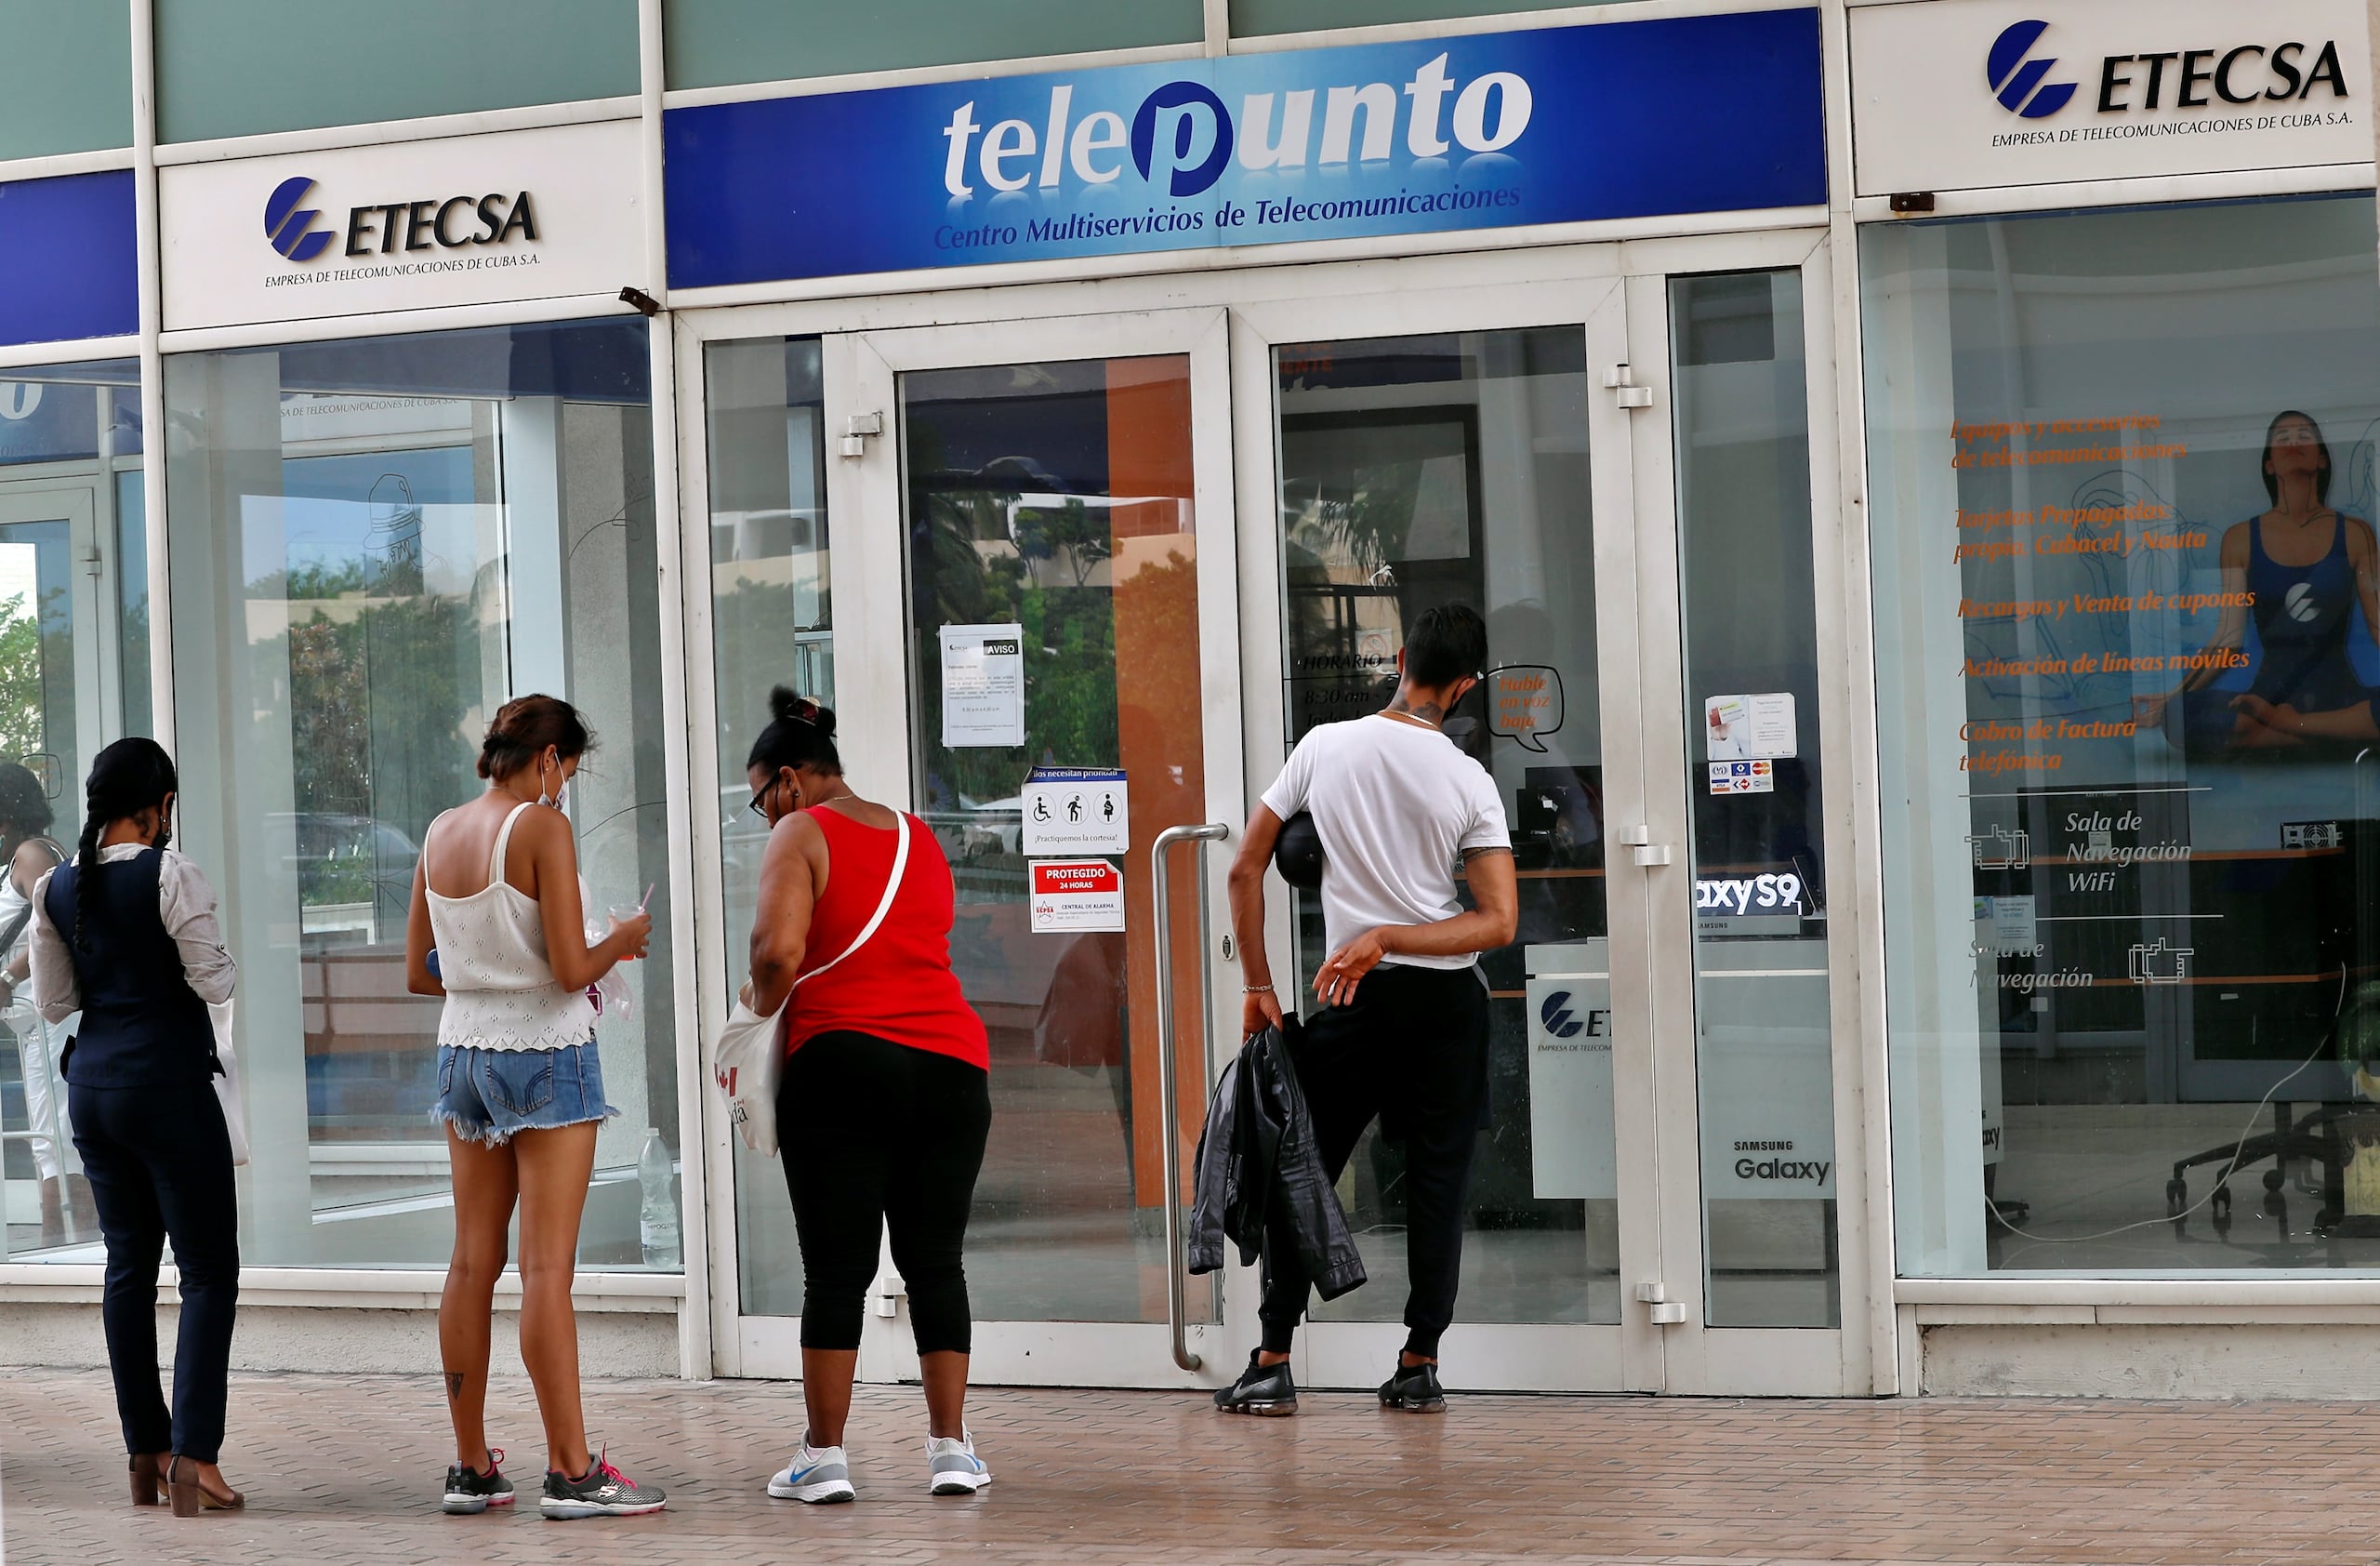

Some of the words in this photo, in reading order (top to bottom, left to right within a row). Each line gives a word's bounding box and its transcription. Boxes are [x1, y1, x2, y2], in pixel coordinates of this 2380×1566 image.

[2097, 41, 2349, 113] ETECSA
[943, 51, 1533, 196] telepunto
[1992, 131, 2055, 147] EMPRESA
[2059, 130, 2078, 143] DE
[2082, 117, 2253, 141] TELECOMUNICACIONES
[2257, 116, 2277, 130] DE
[2281, 113, 2321, 128] CUBA
[2326, 112, 2353, 126] S.A.
[345, 191, 537, 256] ETECSA
[935, 223, 1017, 249] Centro
[1026, 206, 1203, 242] Multiservicios
[1215, 201, 1245, 227] de
[1256, 184, 1521, 225] Telecomunicaciones
[265, 272, 313, 287] EMPRESA
[316, 272, 331, 283] DE
[334, 260, 464, 281] TELECOMUNICACIONES
[468, 259, 483, 270] DE
[484, 256, 517, 269] CUBA
[520, 254, 540, 266] S.A.
[293, 407, 304, 417] DE
[306, 401, 403, 416] TELECOMUNICACIONES
[404, 399, 416, 408] DE
[1950, 418, 2030, 444] Equipos
[2034, 424, 2046, 442] y
[2052, 411, 2162, 434] accesorios
[1950, 448, 1976, 469] de
[1980, 440, 2188, 467] telecomunicaciones
[1954, 508, 2034, 533] Tarjetas
[2035, 531, 2121, 555] Cubacel
[2122, 537, 2135, 558] y
[2140, 530, 2207, 550] Nauta
[1957, 599, 2053, 622] Recargas
[2056, 601, 2069, 620] y
[2073, 593, 2132, 614] Venta
[2137, 590, 2163, 611] de
[2167, 591, 2255, 616] cupones
[987, 644, 1015, 655] AVISO
[1303, 654, 1382, 670] HORARIO
[1958, 654, 2067, 678] Activación
[2071, 653, 2097, 673] de
[2101, 651, 2163, 671] líneas
[2168, 647, 2250, 670] móviles
[1500, 674, 1548, 692] Hable
[1305, 689, 1340, 705] 8:30
[1344, 692, 1369, 703] am
[1500, 697, 1519, 709] en
[1523, 696, 1552, 709] voz
[1501, 712, 1537, 733] baja
[1959, 721, 2022, 742] Cobro
[2027, 720, 2053, 739] de
[2057, 719, 2135, 738] Factura
[1959, 750, 2062, 777] telefónica
[2065, 811, 2111, 832] Sala
[2117, 810, 2143, 831] de
[1082, 833, 1089, 842] la
[2067, 840, 2191, 868] Navegación
[1046, 868, 1105, 879] PROTEGIDO
[2069, 871, 2116, 892] WiFi
[1734, 1141, 1792, 1151] SAMSUNG
[1735, 1158, 1830, 1186] Galaxy
